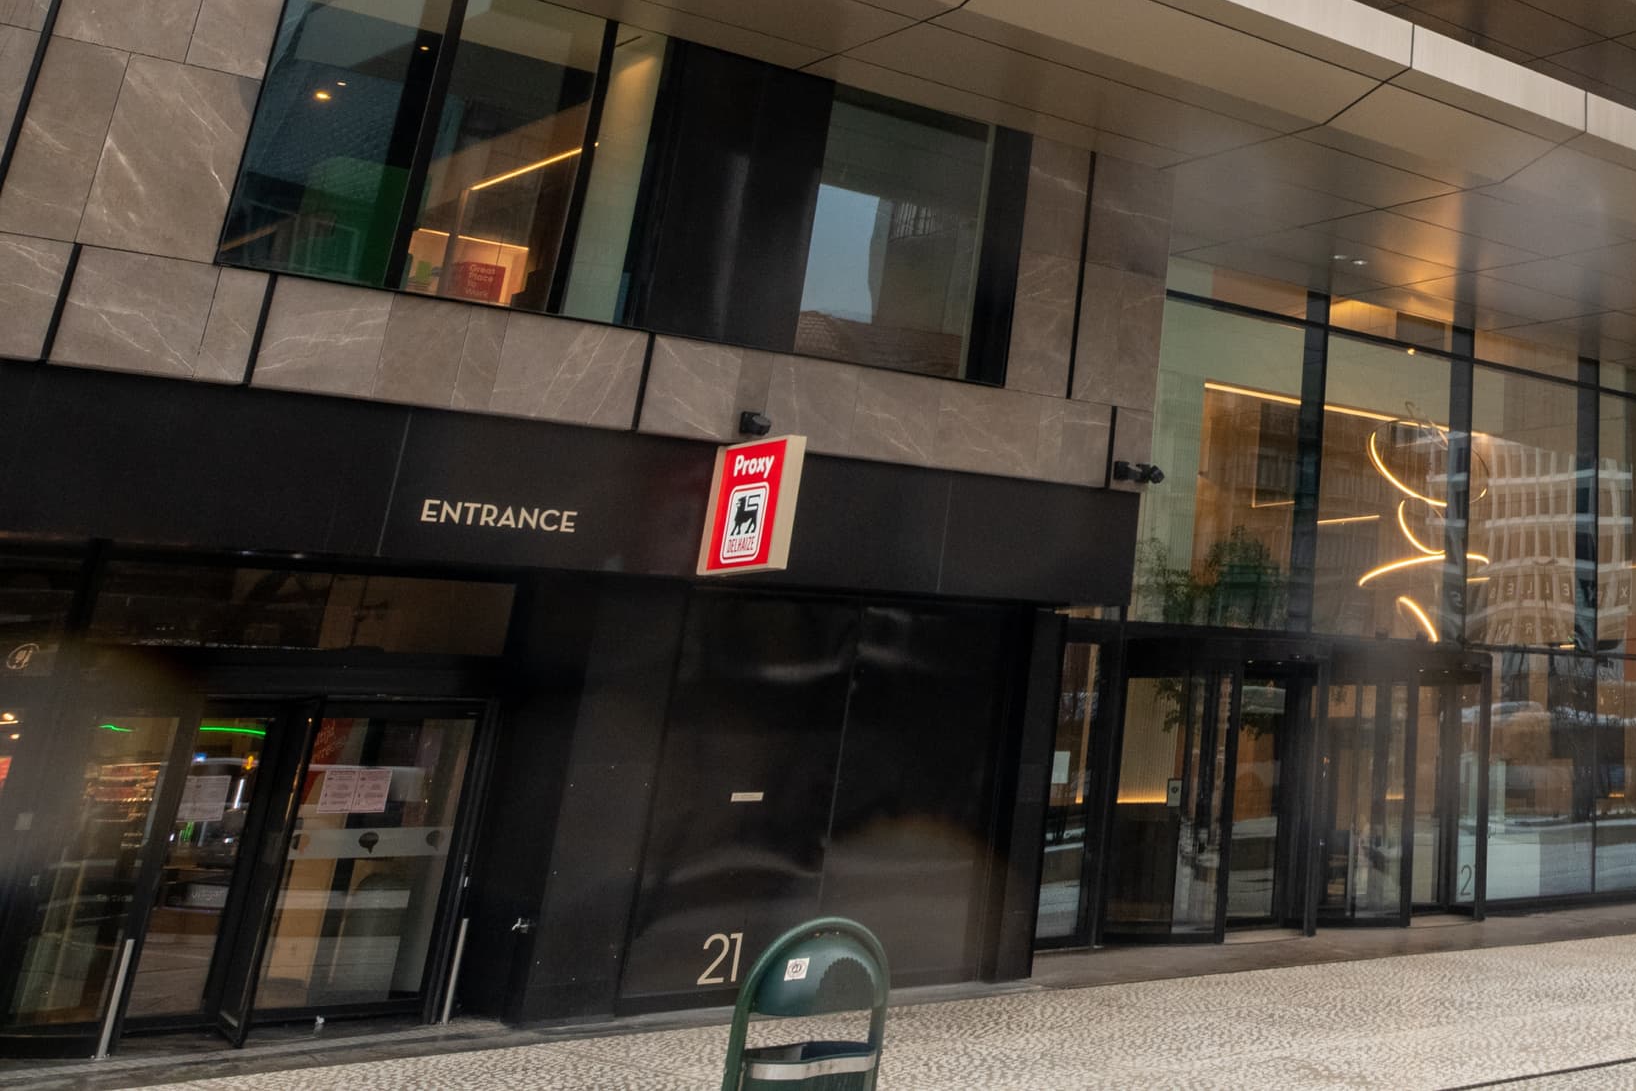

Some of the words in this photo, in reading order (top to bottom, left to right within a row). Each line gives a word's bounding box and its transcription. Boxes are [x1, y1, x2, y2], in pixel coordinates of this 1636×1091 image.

[733, 454, 775, 479] Proxy
[420, 498, 579, 533] ENTRANCE
[726, 535, 756, 554] DELHAIZE
[696, 932, 744, 985] 21
